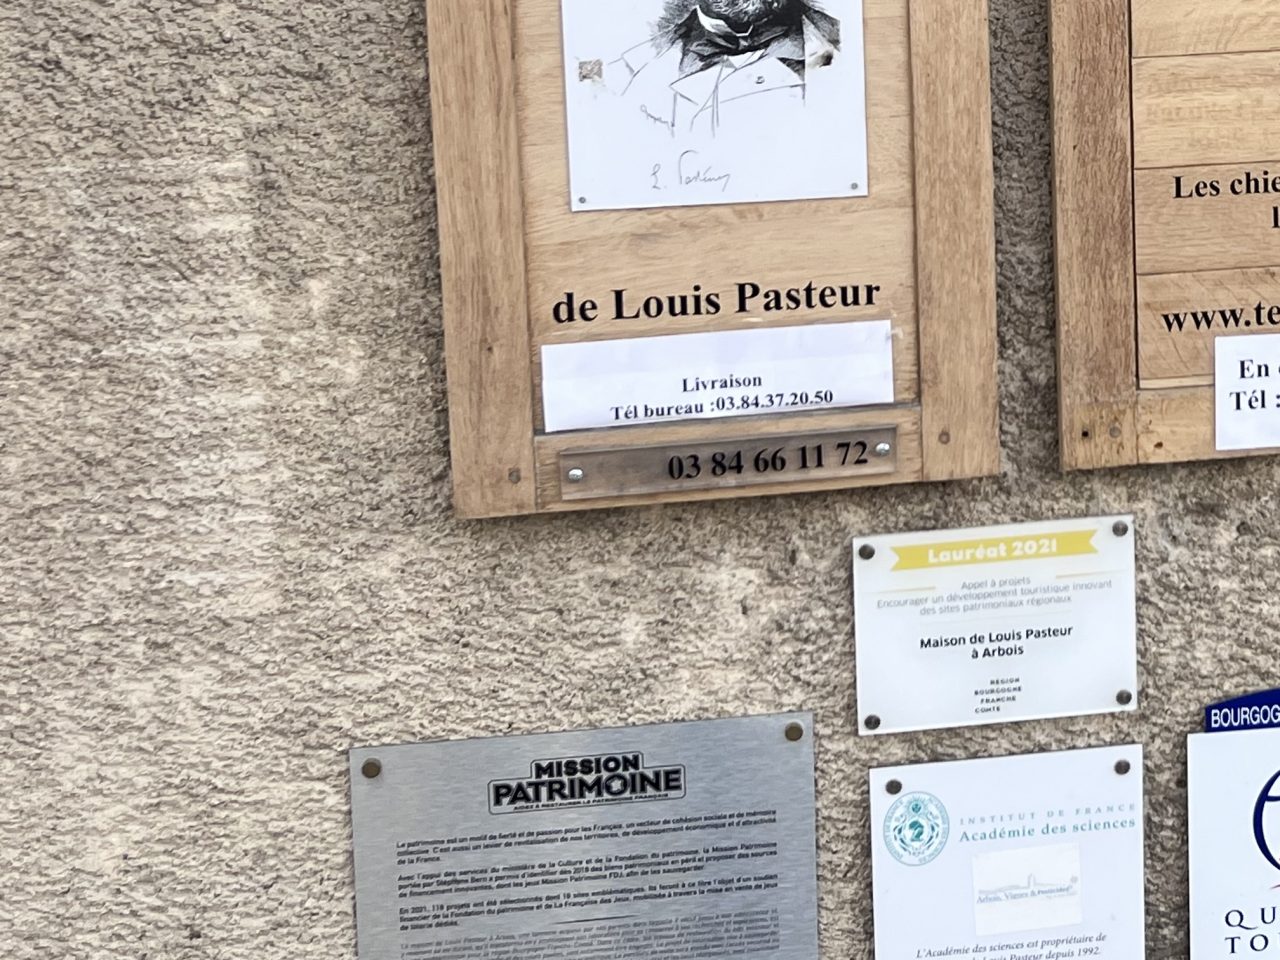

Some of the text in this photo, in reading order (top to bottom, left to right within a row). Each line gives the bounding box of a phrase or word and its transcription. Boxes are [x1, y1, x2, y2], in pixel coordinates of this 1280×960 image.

[1173, 173, 1220, 199] Les
[552, 280, 881, 323] de Louis Pasteur
[1238, 359, 1271, 380] En
[682, 374, 762, 393] Livraison
[610, 404, 638, 421] Tél
[644, 400, 704, 418] bureau
[1230, 389, 1266, 411] Tél
[668, 440, 868, 480] 03 84 66 11 72
[928, 538, 1057, 564] Lauréat 2021
[877, 579, 1112, 610] Encourager un développement touristique innovant
[961, 576, 1031, 591] Appel à projets
[920, 595, 1071, 616] des sites patrimoniaux régionaux
[920, 625, 1073, 650] Maison de Louis Pasteur
[971, 644, 1024, 660] à Arbois
[534, 754, 641, 780] MISSION
[493, 768, 682, 807] PATRIMOINE
[960, 803, 1136, 825] INSTITUT DE FRANCE
[959, 818, 1135, 842] Académie des sciences
[916, 933, 1106, 958] L'Académie des sciences est propriétaire de
[1044, 948, 1074, 960] depuis
